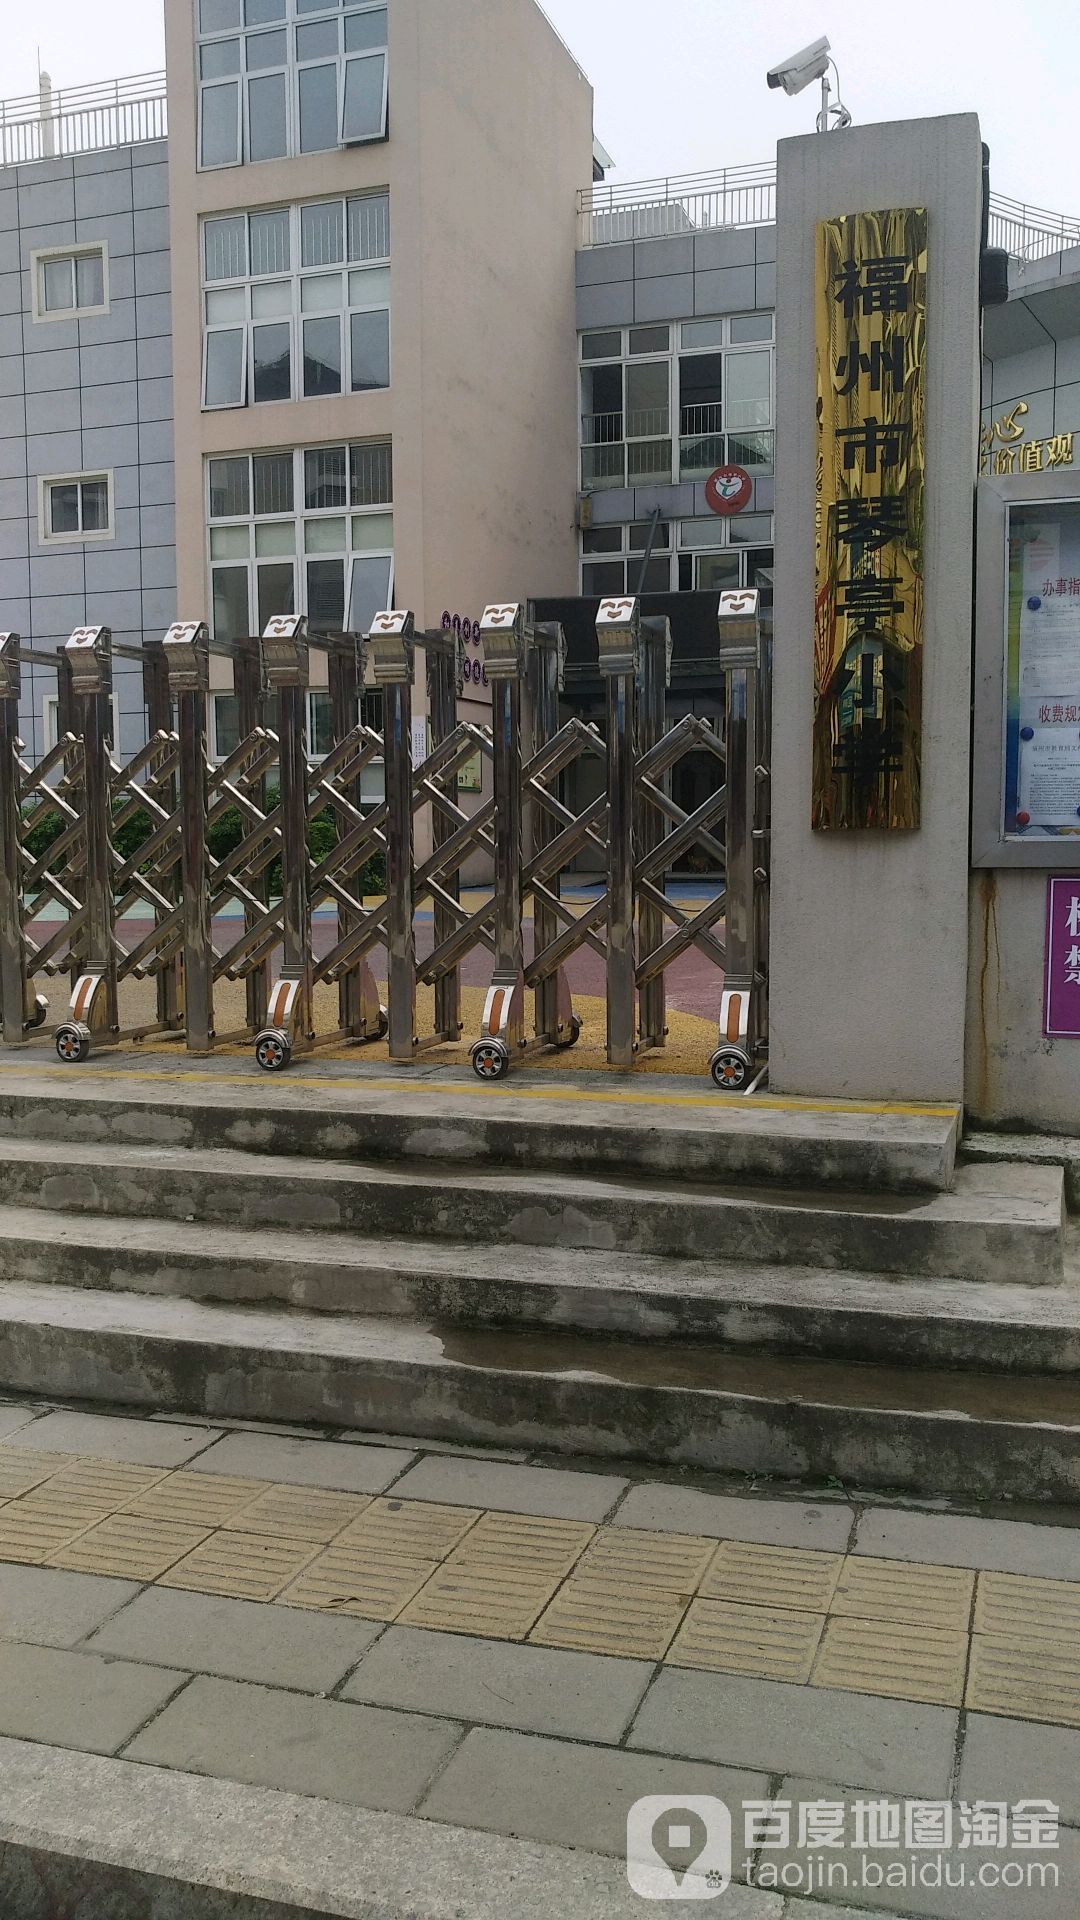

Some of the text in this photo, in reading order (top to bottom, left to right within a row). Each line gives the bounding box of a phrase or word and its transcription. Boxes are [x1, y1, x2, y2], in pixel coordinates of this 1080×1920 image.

[981, 433, 1072, 475] 价值观
[833, 255, 910, 787] 福州市琴亭小学
[1038, 704, 1080, 723] 收费规
